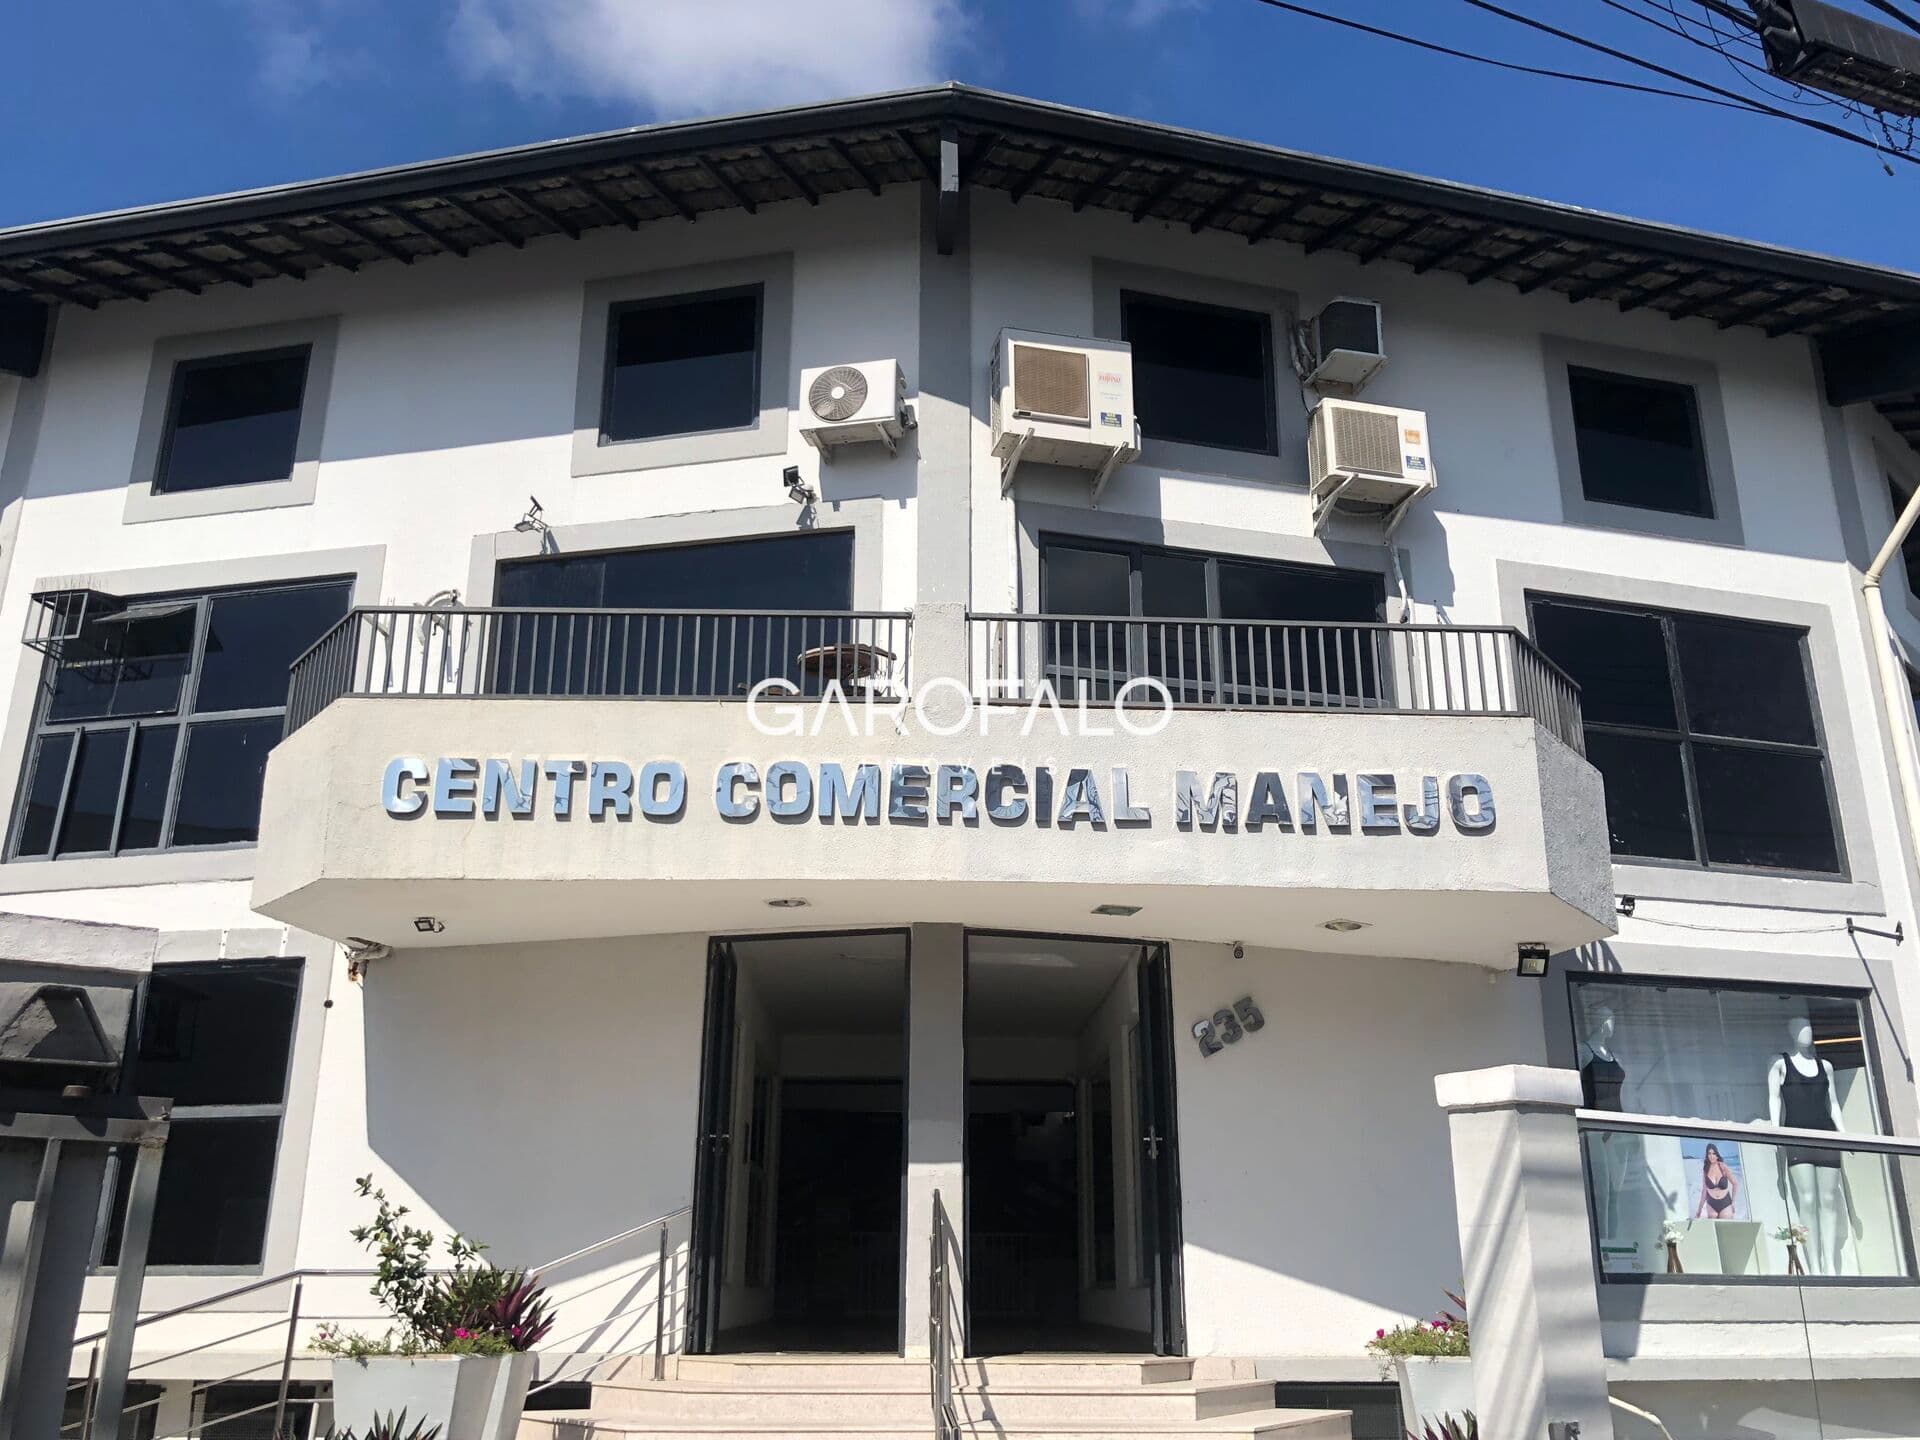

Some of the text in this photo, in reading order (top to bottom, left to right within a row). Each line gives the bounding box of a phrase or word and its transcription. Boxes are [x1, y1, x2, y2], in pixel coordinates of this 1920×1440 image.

[382, 757, 1497, 836] CENTRO COMERCIAL MANEJO
[1192, 996, 1265, 1058] 235
